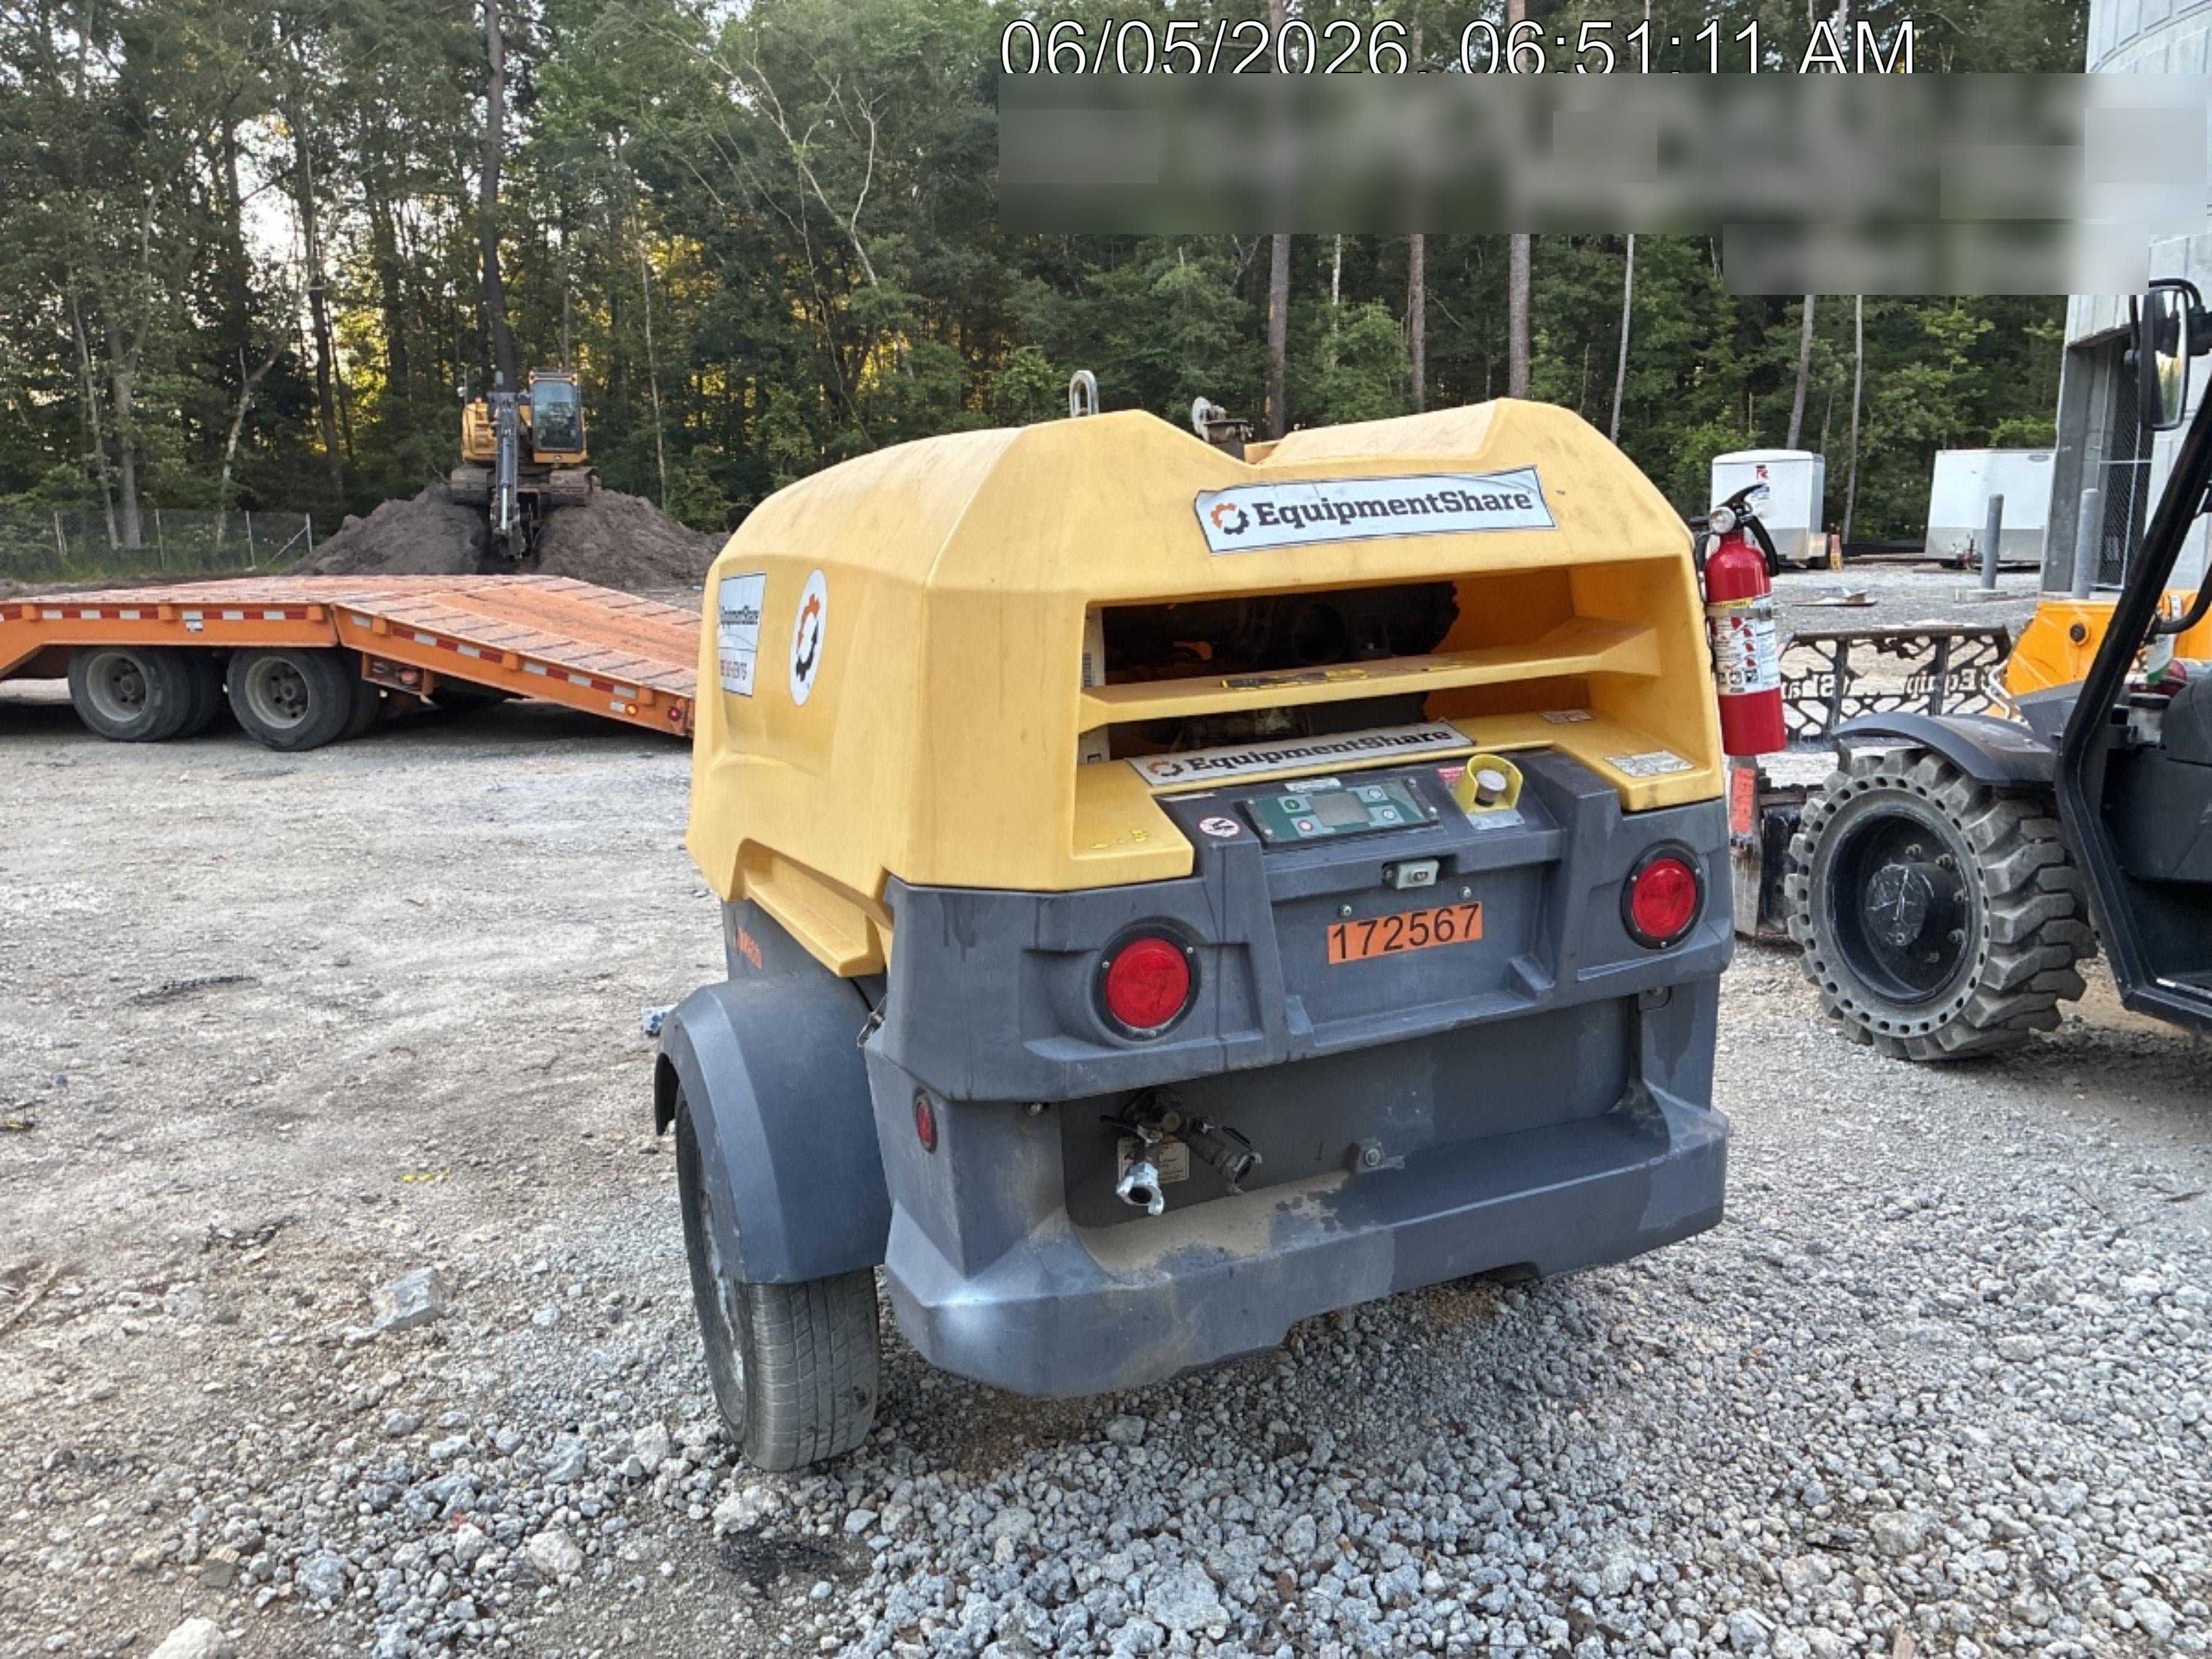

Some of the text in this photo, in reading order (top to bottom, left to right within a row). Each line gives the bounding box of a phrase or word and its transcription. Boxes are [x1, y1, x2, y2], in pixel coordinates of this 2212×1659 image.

[1252, 490, 1532, 529] EquipmentShare
[1185, 731, 1452, 770] EquipmentShare
[1332, 904, 1479, 959] 172567
